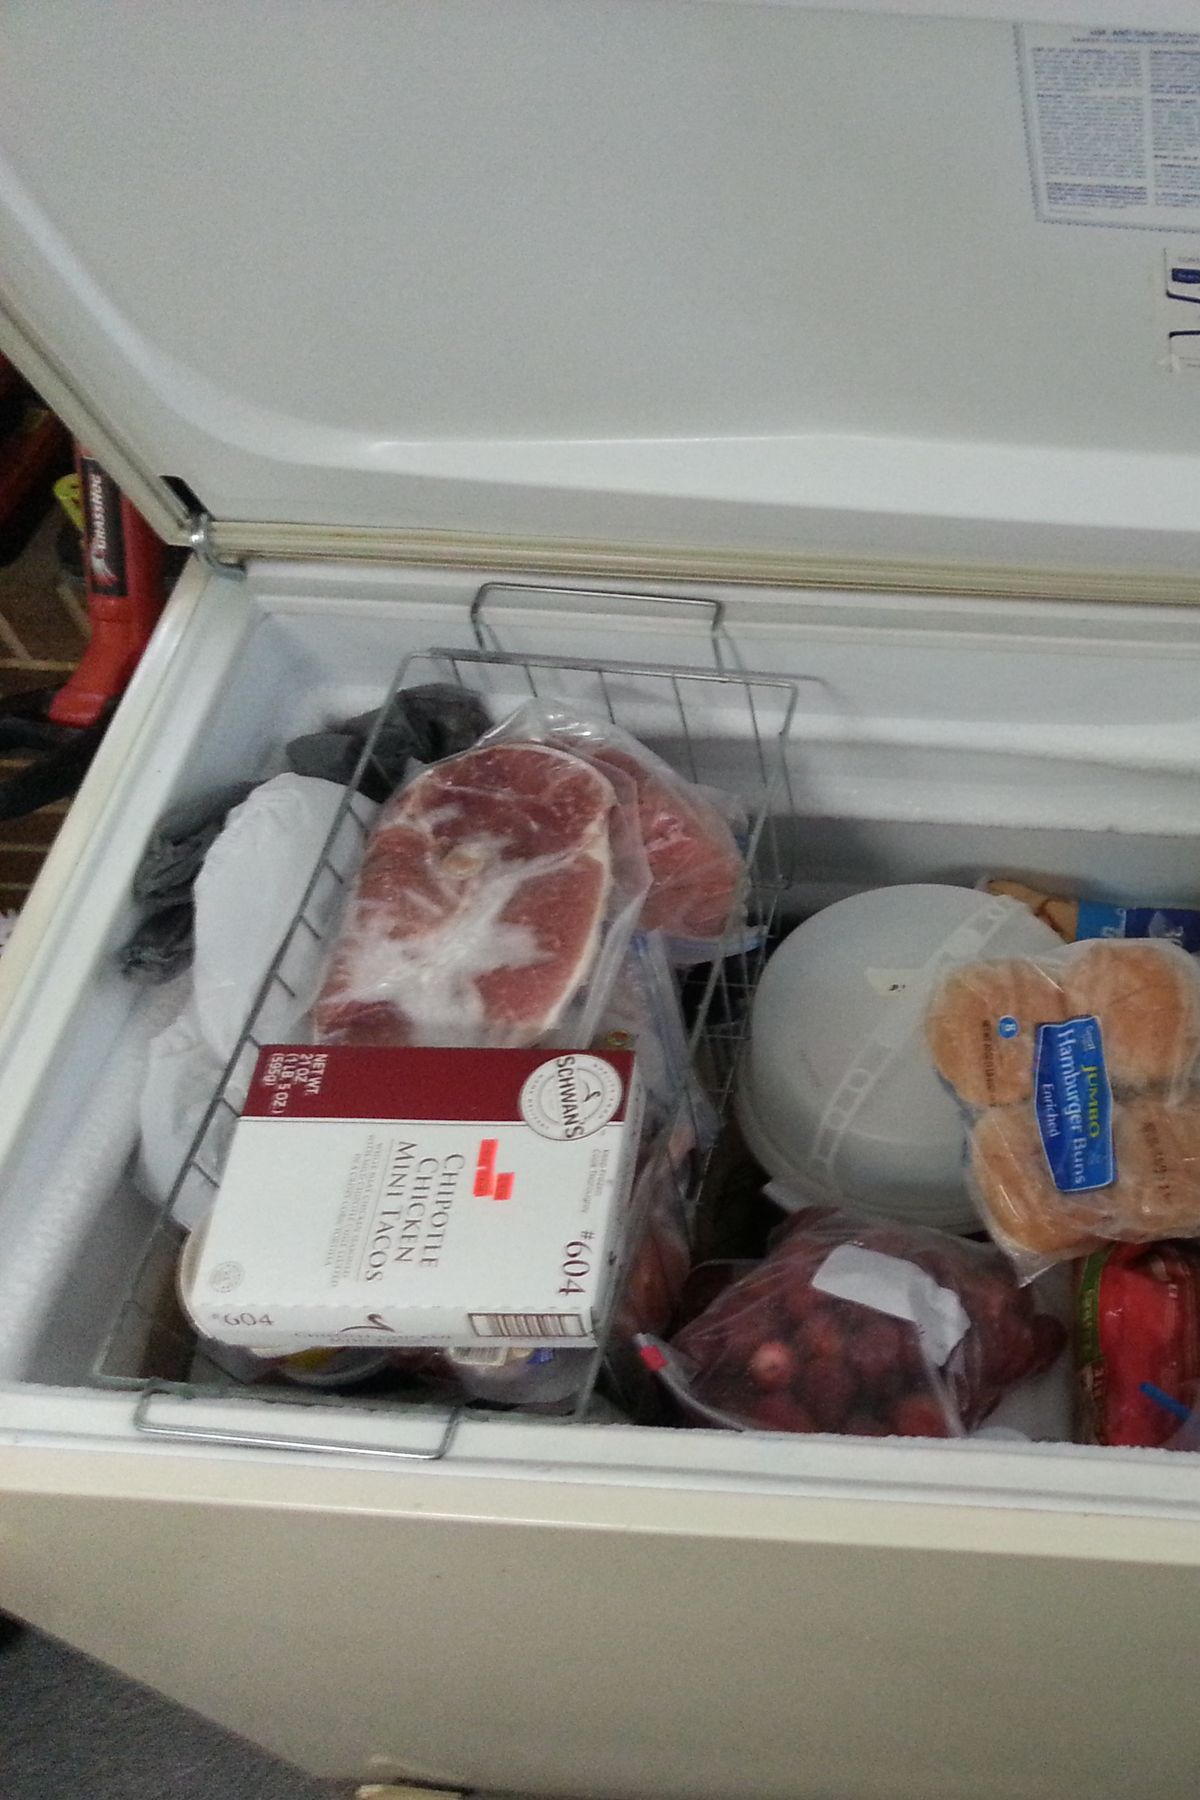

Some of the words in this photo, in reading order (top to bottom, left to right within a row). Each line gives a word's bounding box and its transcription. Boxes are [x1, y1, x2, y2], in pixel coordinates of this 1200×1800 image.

[262, 1052, 286, 1087] (595g)
[275, 1083, 292, 1092] 5
[284, 1053, 301, 1064] (1
[298, 1053, 314, 1068] 21
[307, 1053, 329, 1075] NET
[556, 1056, 585, 1139] SCHWAN'S
[1041, 1083, 1060, 1138] Enriched
[1056, 1028, 1086, 1134] Hamburger
[1071, 1137, 1087, 1184] Buns
[1080, 1064, 1101, 1138] JUMBO
[385, 1140, 419, 1199] MINI
[392, 1157, 441, 1264] CHICKEN
[420, 1153, 467, 1269] CHIPOTLE
[364, 1207, 404, 1282] TACOS
[557, 1230, 597, 1297] #604
